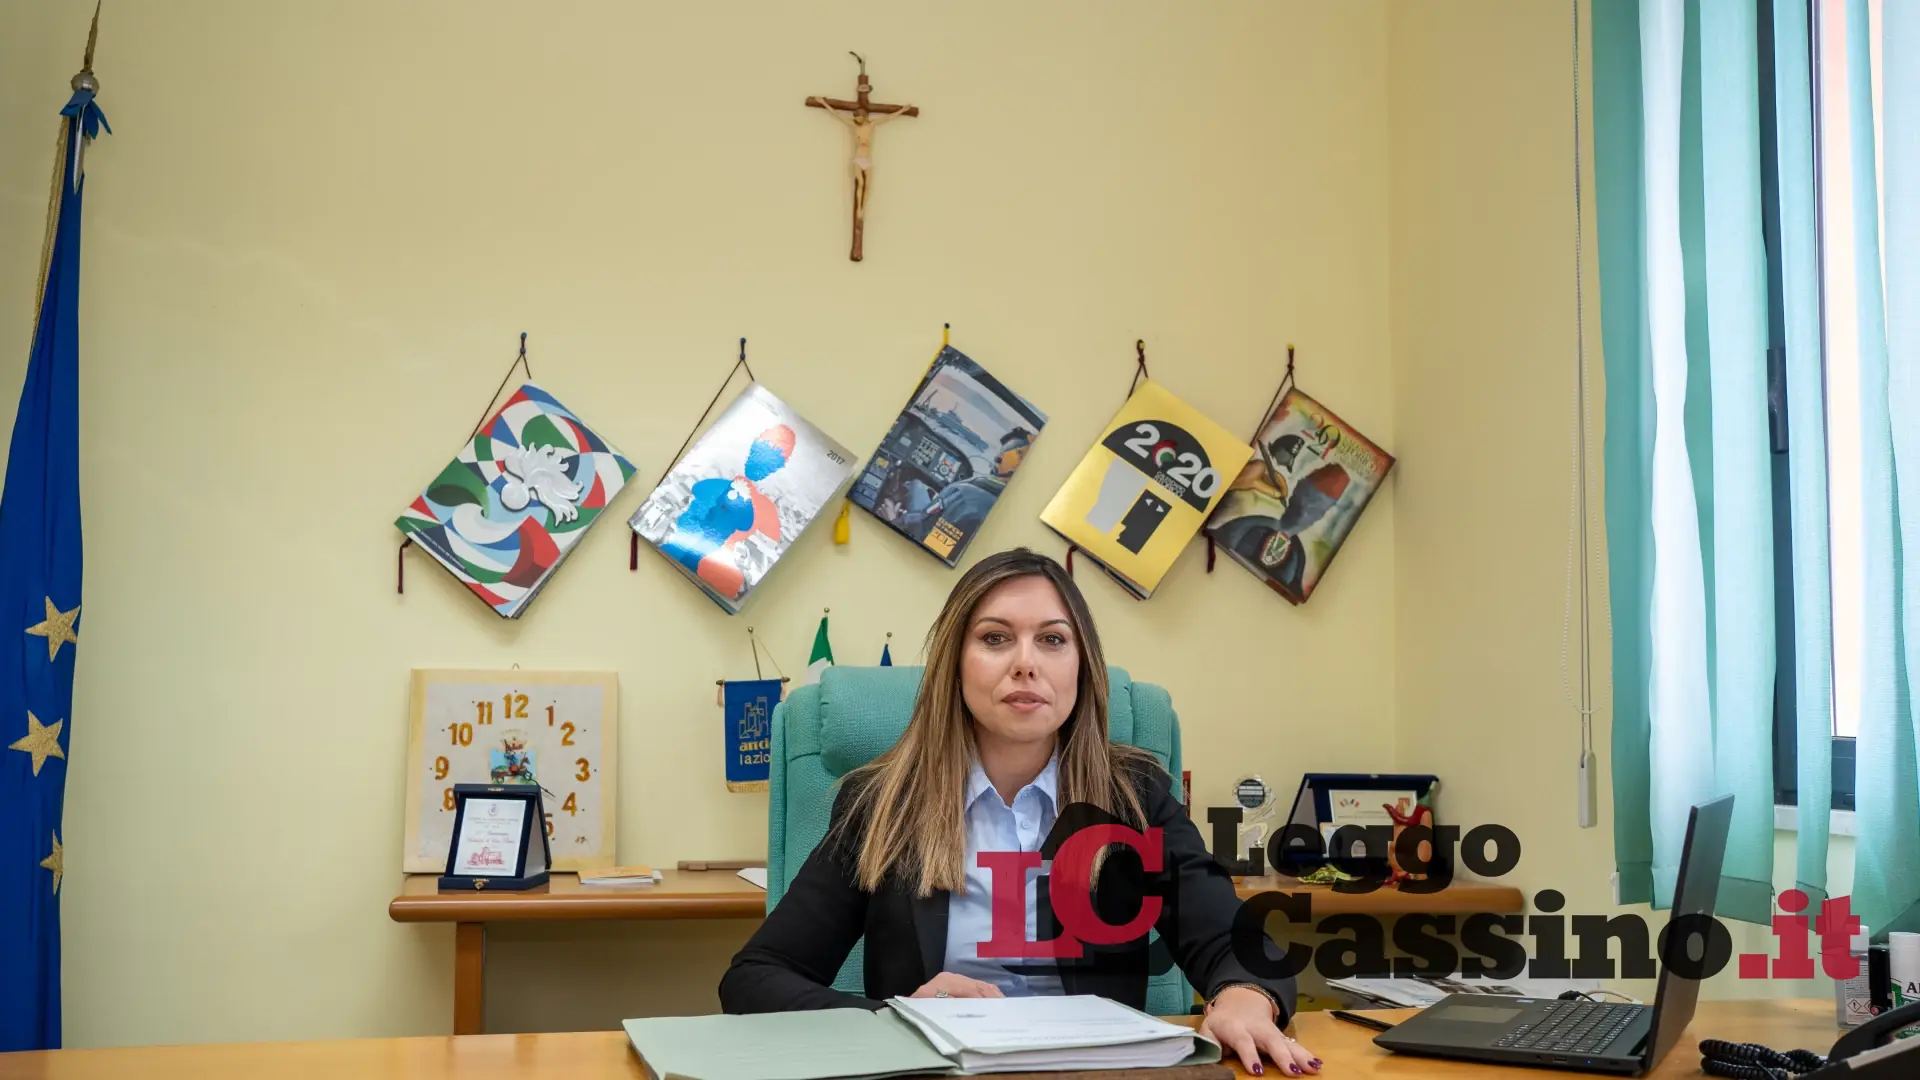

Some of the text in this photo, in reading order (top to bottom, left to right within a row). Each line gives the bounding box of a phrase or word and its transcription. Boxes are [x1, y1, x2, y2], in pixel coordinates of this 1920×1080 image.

[826, 449, 846, 465] 2017
[476, 701, 493, 725] 11
[503, 693, 529, 719] 12
[545, 705, 554, 727] 1
[448, 722, 473, 747] 10
[560, 721, 576, 746] 2
[434, 755, 450, 780] 9
[575, 757, 591, 782] 3
[740, 751, 770, 765] lazio
[443, 787, 457, 812] 8
[561, 791, 577, 817] 4
